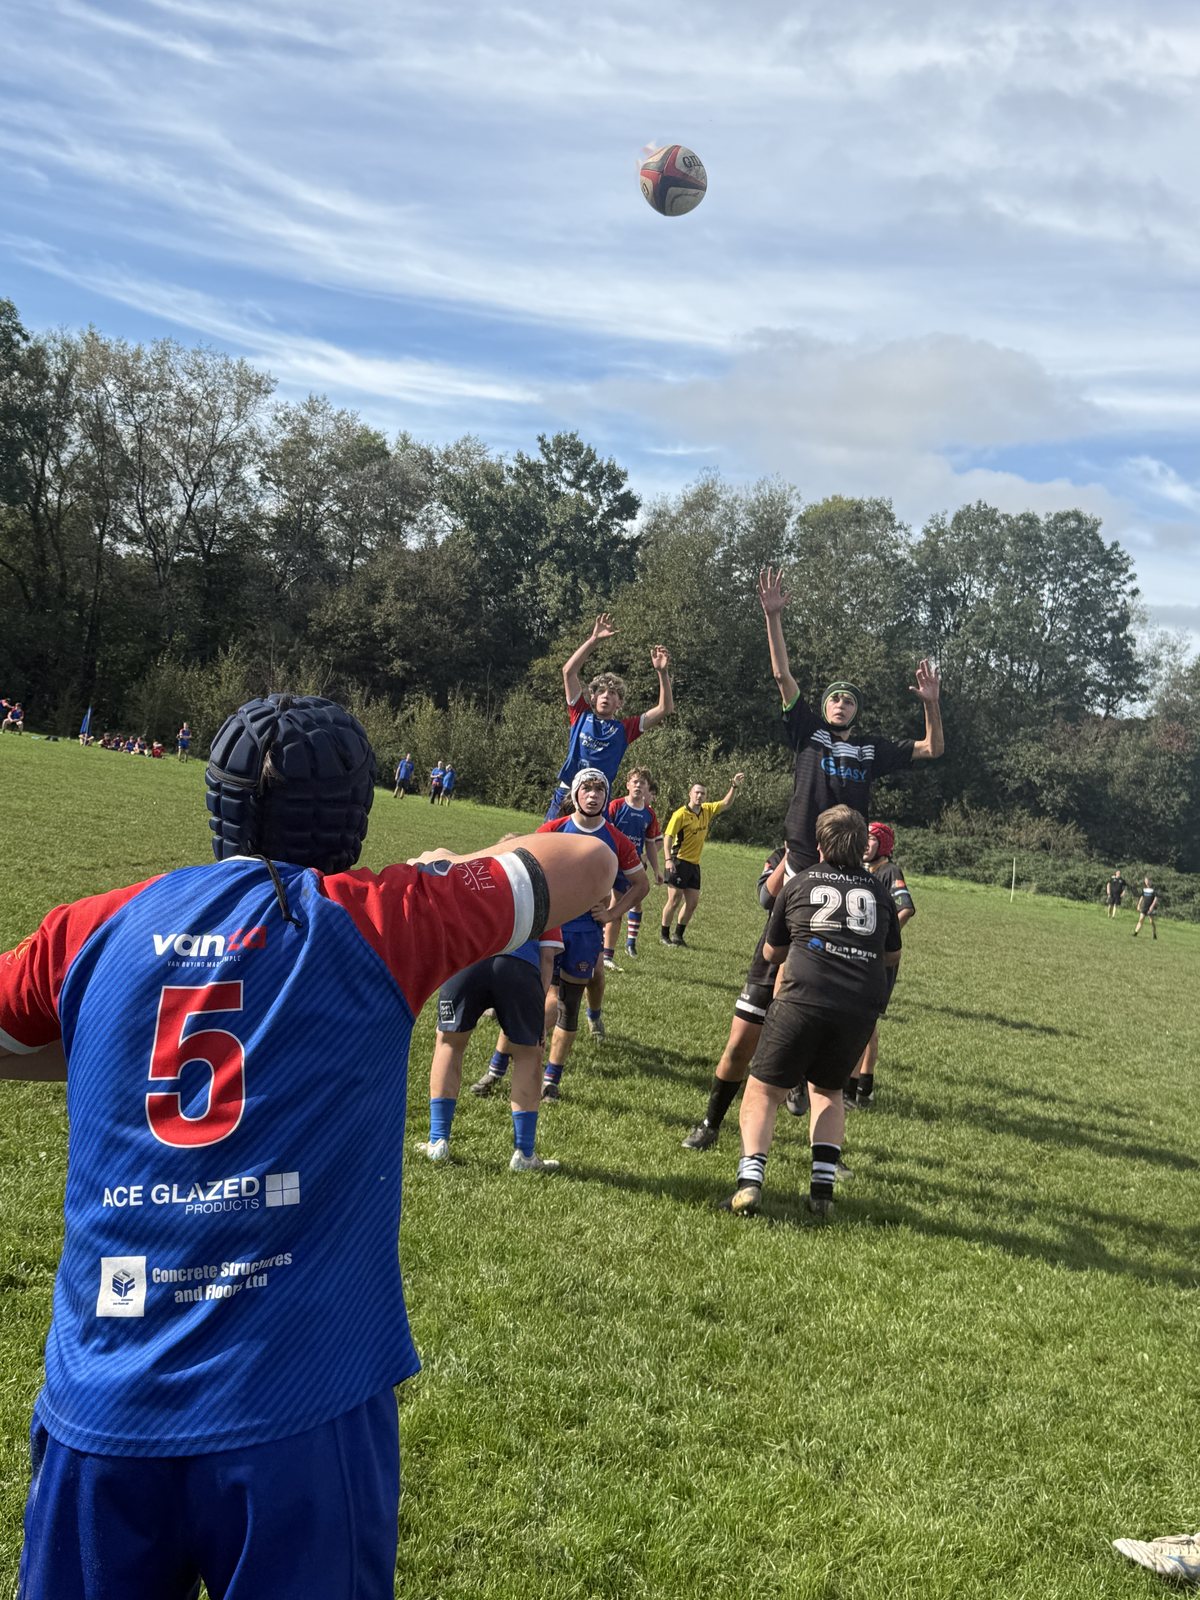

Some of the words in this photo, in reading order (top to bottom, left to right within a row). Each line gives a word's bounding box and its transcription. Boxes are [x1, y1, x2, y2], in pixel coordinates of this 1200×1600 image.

[809, 884, 877, 936] 29
[825, 941, 850, 953] Ryan
[850, 947, 877, 959] Payne
[145, 979, 246, 1148] 5
[102, 1186, 143, 1208] ACE
[151, 1176, 260, 1205] GLAZED
[185, 1198, 260, 1215] PRODUCTS
[152, 1265, 217, 1283] Concrete
[220, 1252, 293, 1278] Structures
[174, 1285, 203, 1304] and
[205, 1280, 245, 1301] Floors
[245, 1273, 268, 1289] Ltd
